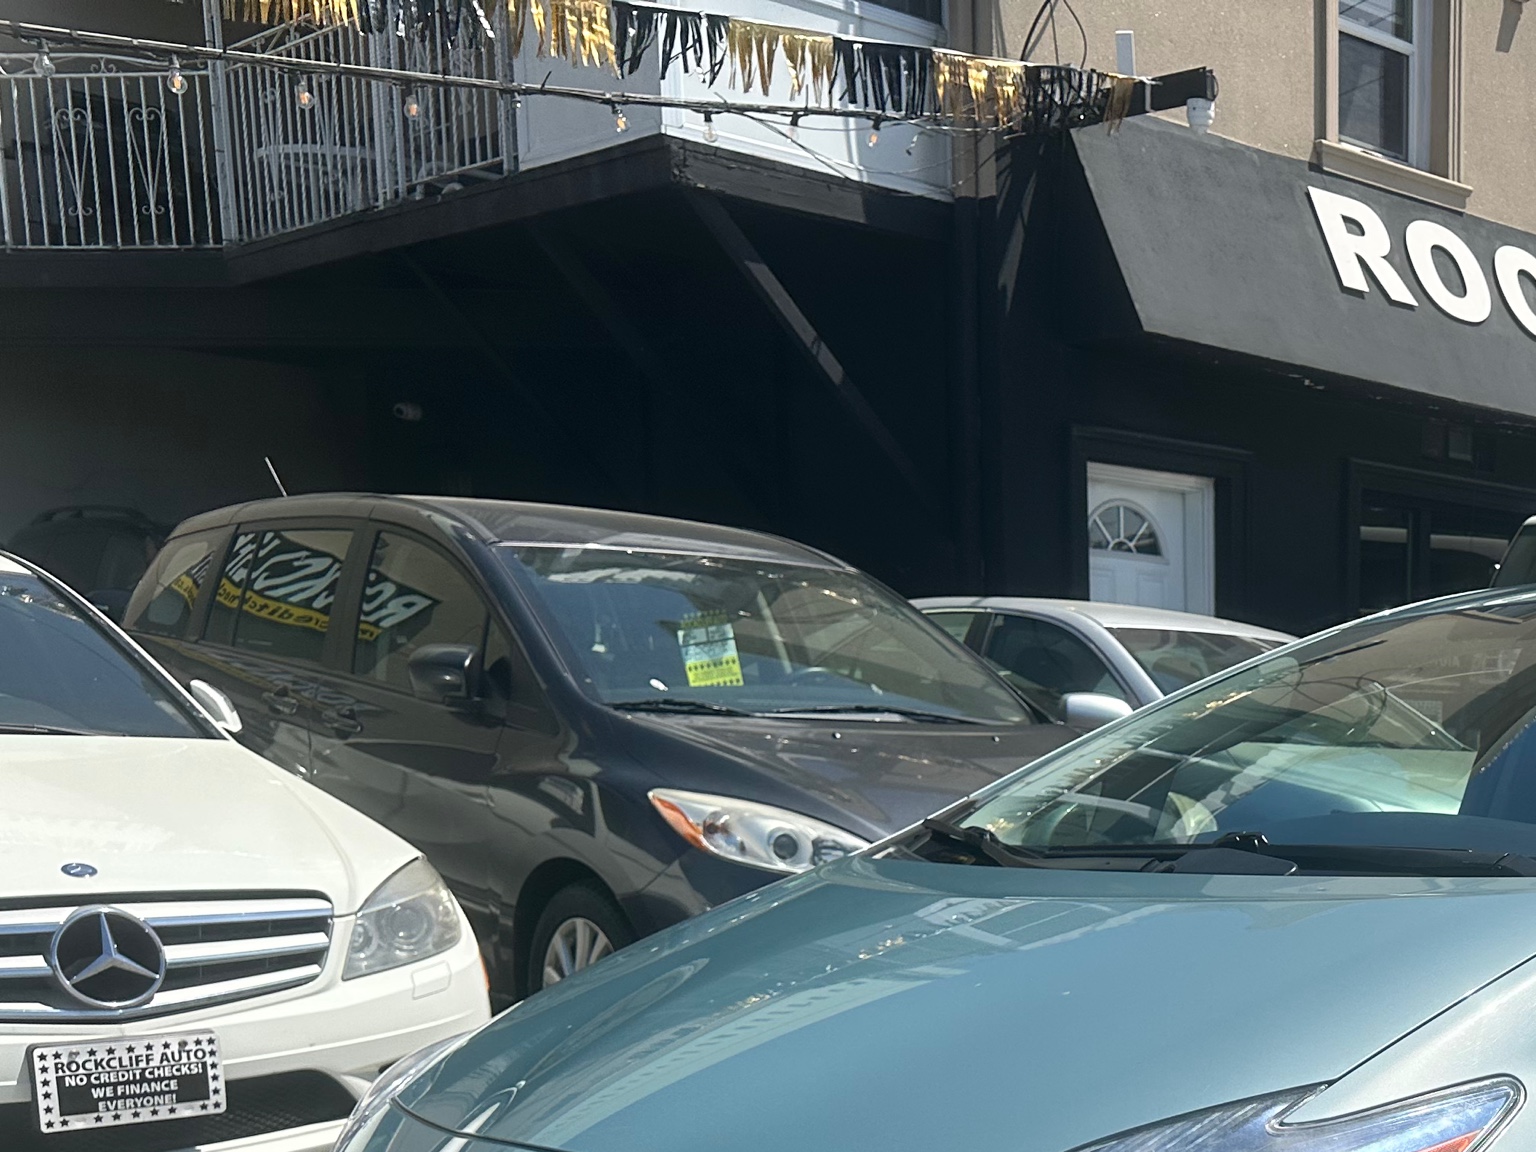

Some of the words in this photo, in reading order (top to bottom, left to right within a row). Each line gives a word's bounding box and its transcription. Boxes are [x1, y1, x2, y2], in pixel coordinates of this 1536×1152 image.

[54, 1053, 155, 1075] ROCKCLIFF
[159, 1048, 207, 1064] AUTO
[64, 1074, 87, 1087] NO
[91, 1069, 141, 1084] CREDIT
[145, 1062, 203, 1079] CHECKS!
[91, 1086, 114, 1099] WE
[117, 1080, 178, 1096] FINANCE
[98, 1093, 177, 1112] EVERYONE!
